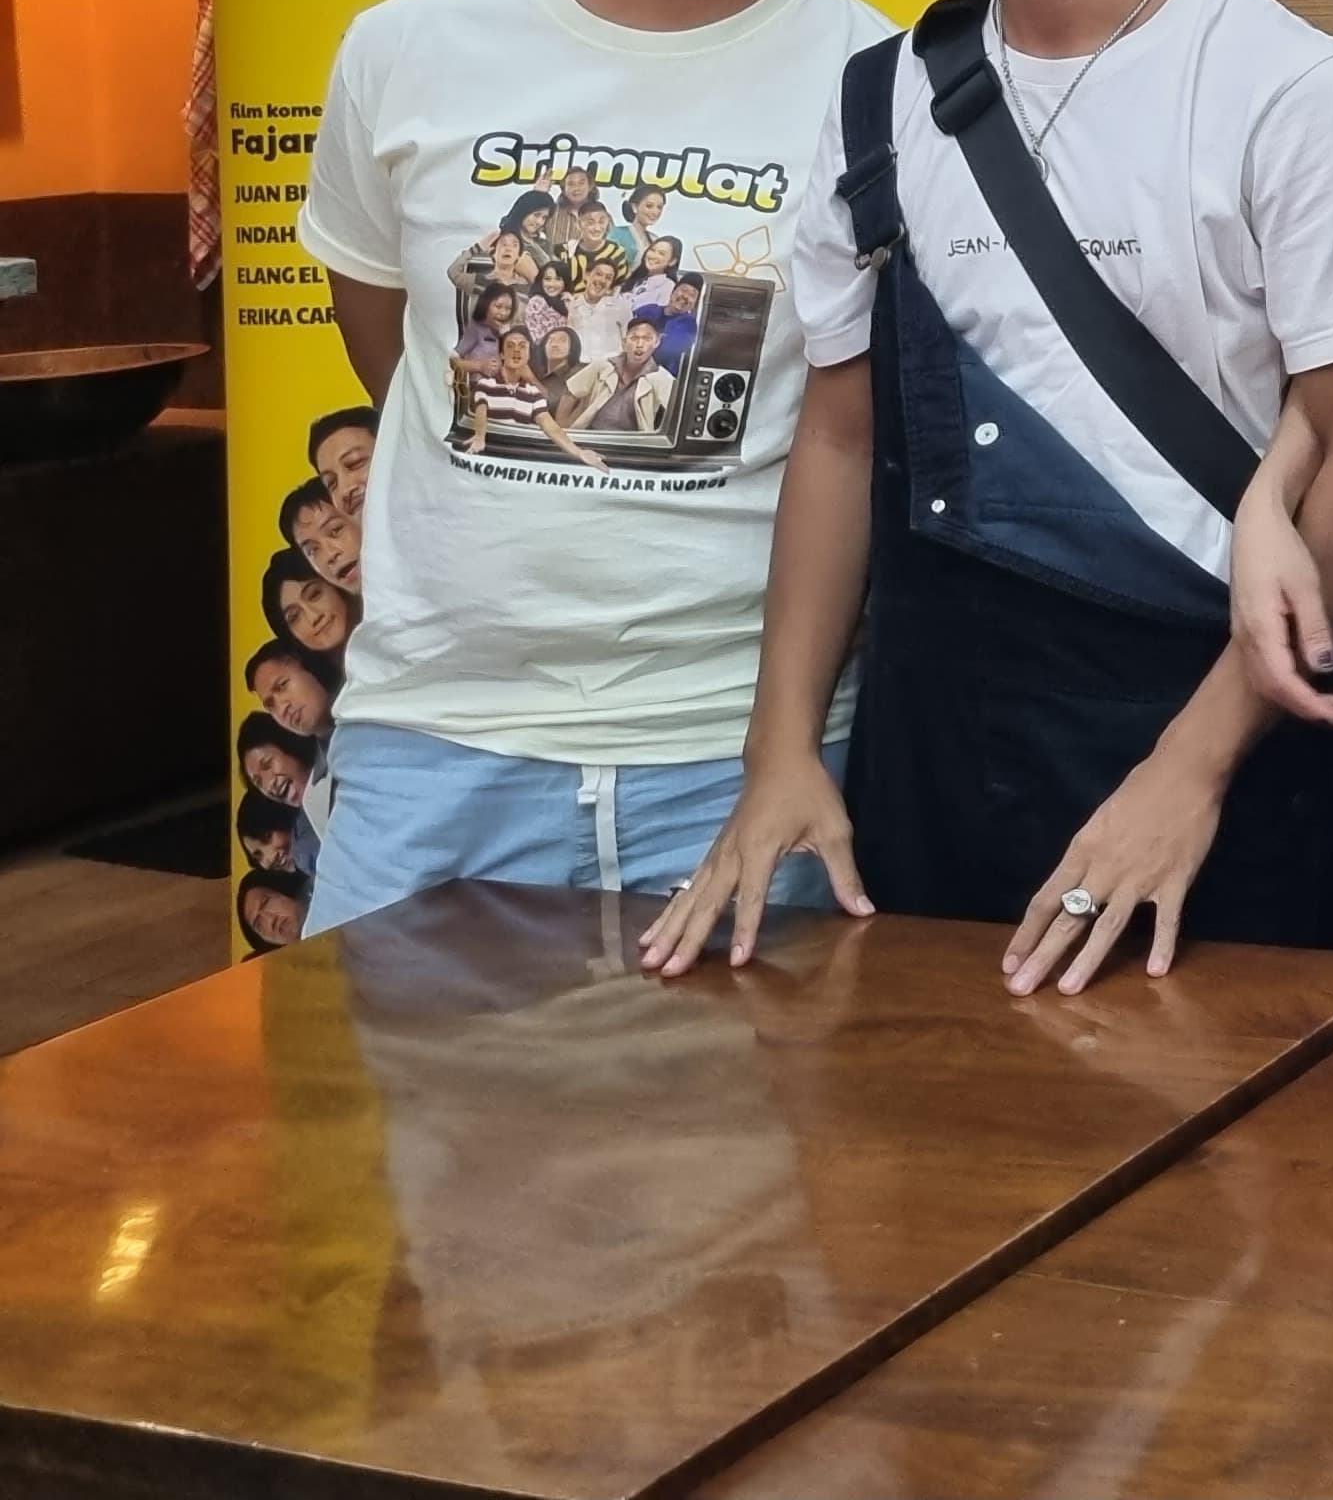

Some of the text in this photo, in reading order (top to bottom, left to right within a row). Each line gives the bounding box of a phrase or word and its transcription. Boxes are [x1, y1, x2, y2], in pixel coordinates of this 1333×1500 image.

[230, 103, 323, 118] film kome
[231, 126, 317, 161] Fajar
[471, 131, 788, 213] Srimulat
[234, 184, 309, 204] JUAN BI
[236, 226, 297, 244] INDAH
[237, 266, 324, 285] ELANG EL
[238, 306, 337, 326] ERIKA CAR
[474, 461, 532, 483] KOMEDI
[535, 472, 595, 489] KARYA
[600, 476, 656, 492] FAJAR
